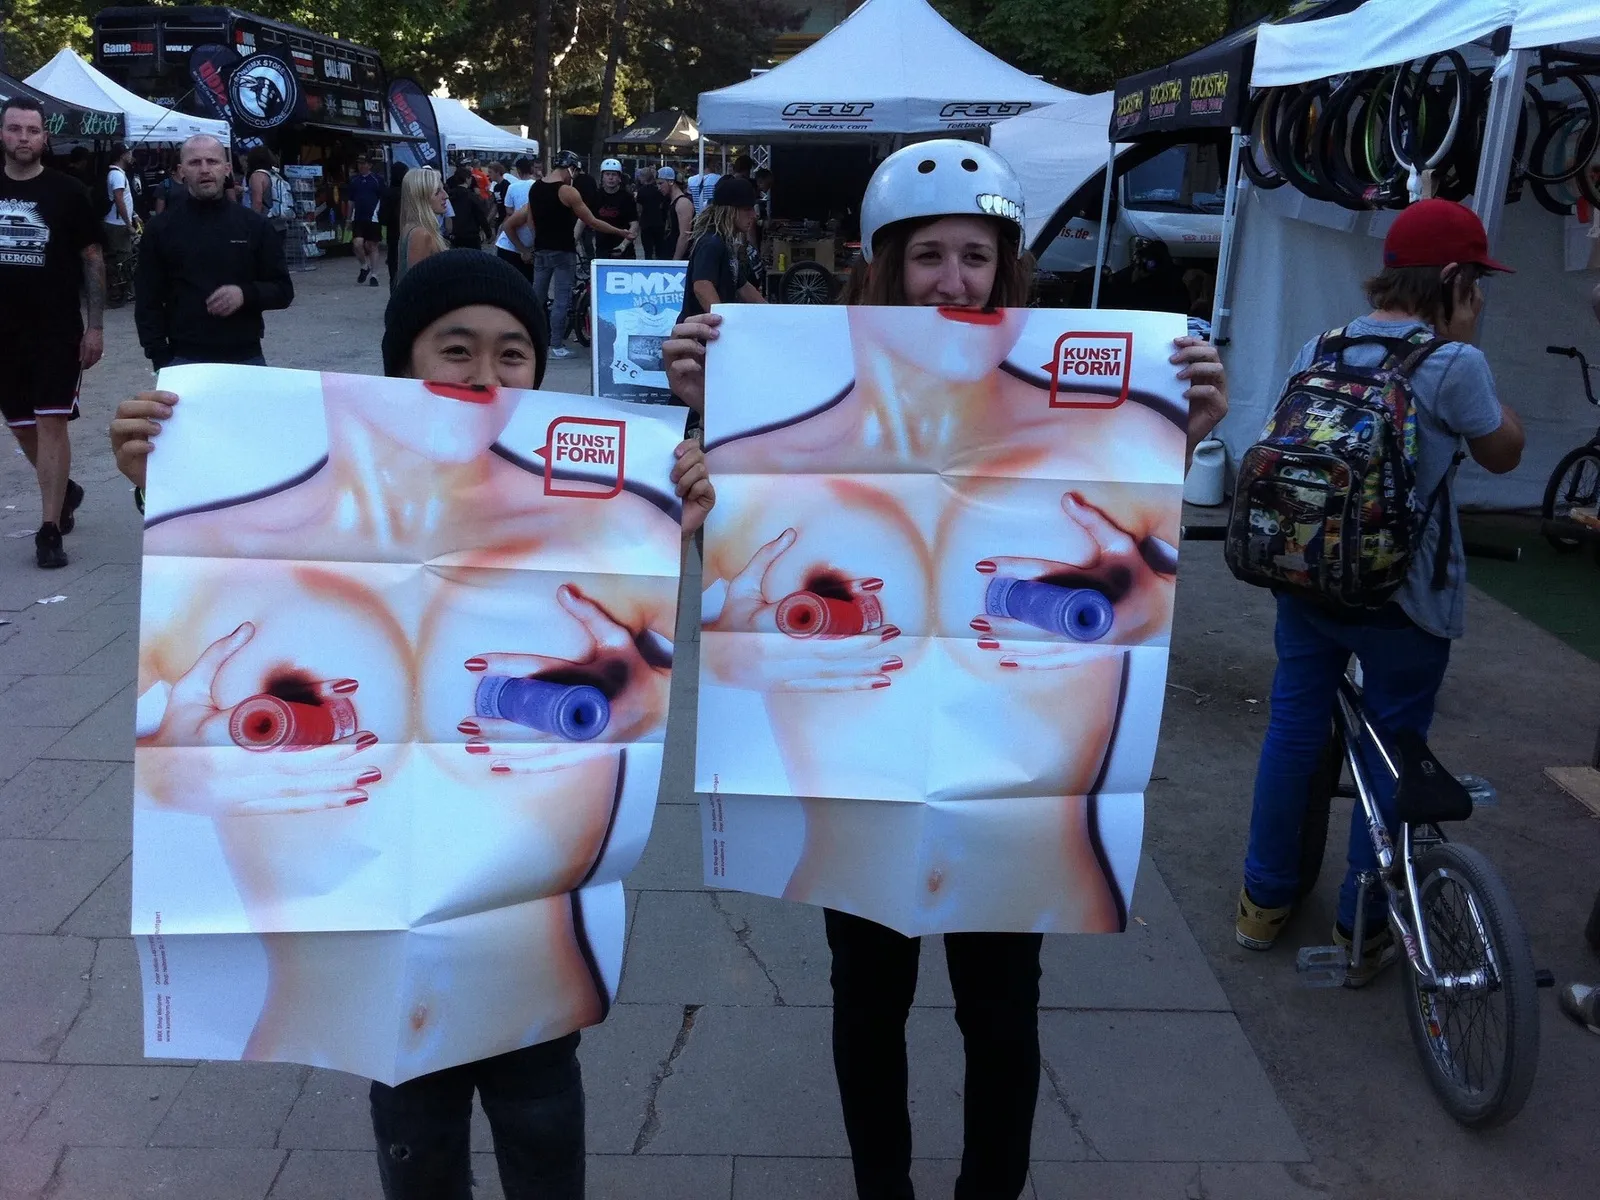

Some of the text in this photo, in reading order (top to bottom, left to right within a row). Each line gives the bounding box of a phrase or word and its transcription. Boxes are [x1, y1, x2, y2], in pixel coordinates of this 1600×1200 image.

[1190, 70, 1229, 99] ROCKSTAR
[782, 102, 874, 116] FELT
[940, 102, 1031, 117] FELT
[255, 111, 287, 126] COLOGNE
[0, 253, 44, 265] KEROSIN
[605, 272, 687, 295] BMX
[1063, 348, 1122, 360] KUNST
[614, 360, 629, 373] 15
[1063, 361, 1120, 375] FORM
[557, 432, 615, 448] KUNST
[556, 446, 615, 464] FORM
